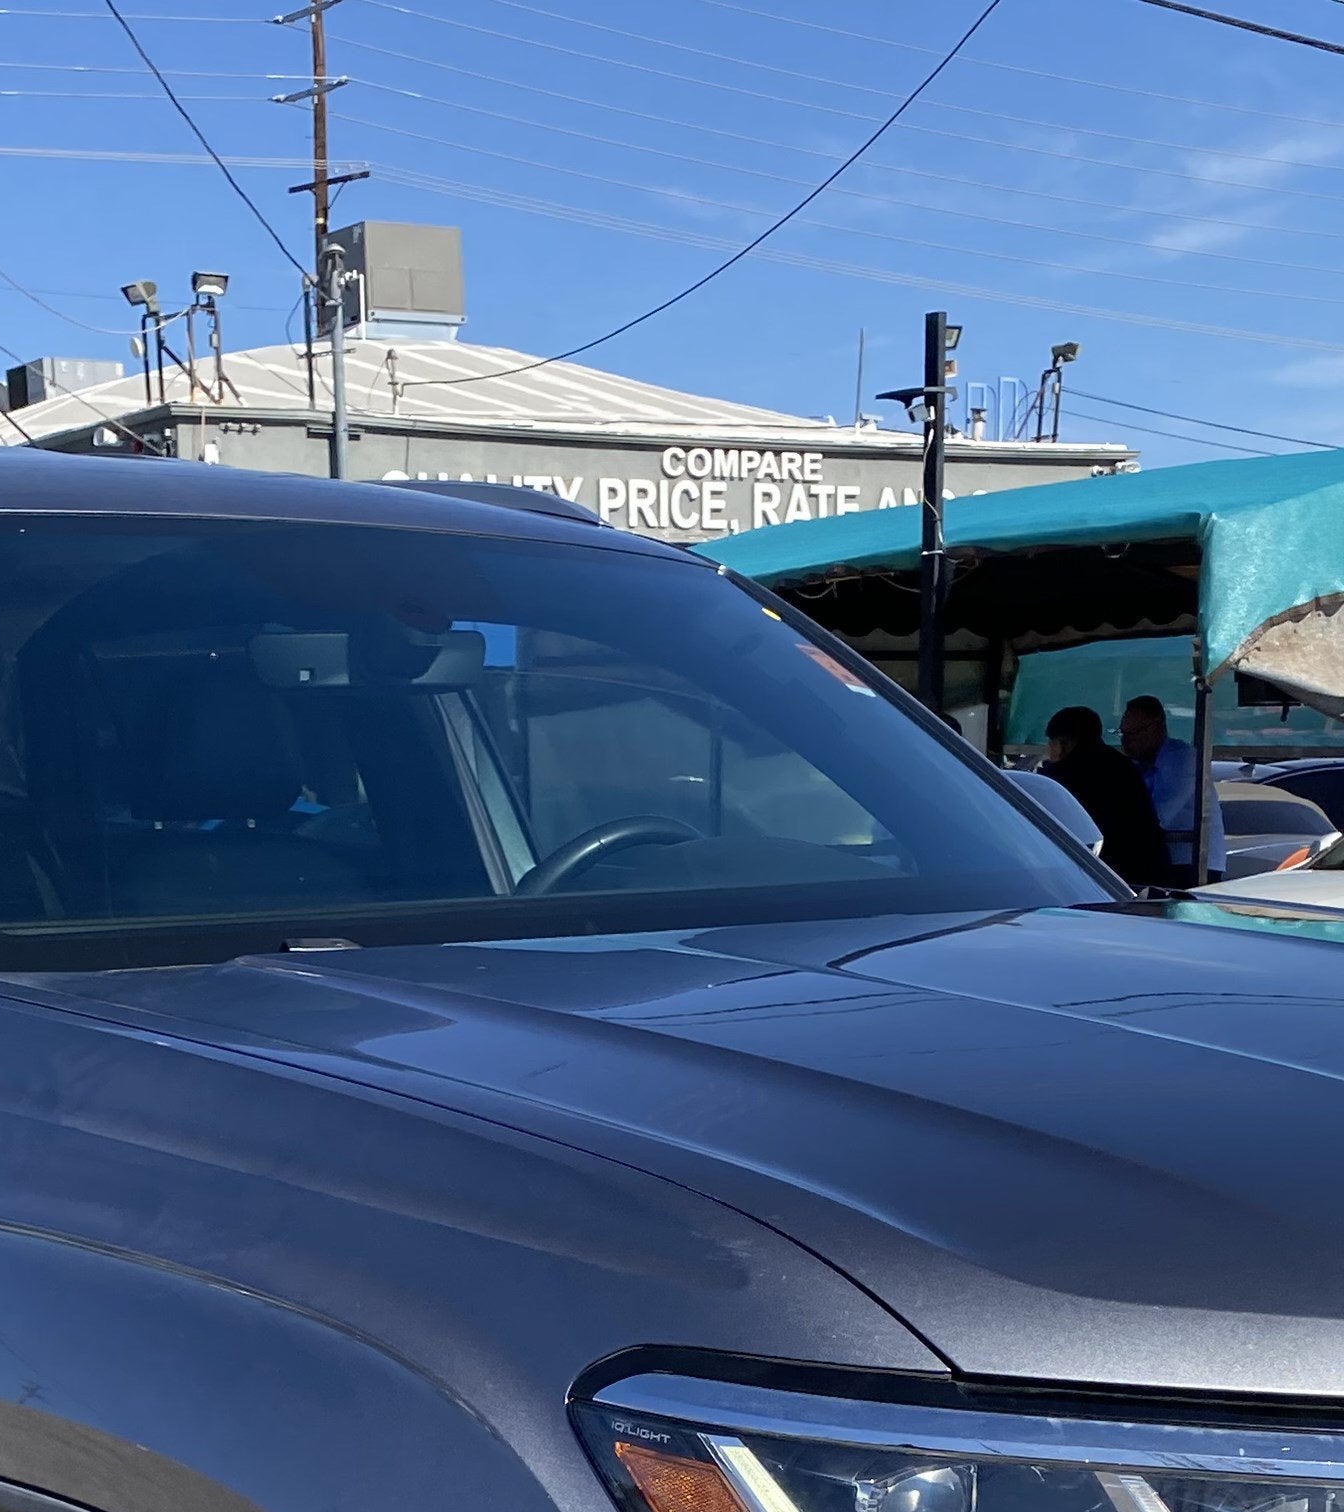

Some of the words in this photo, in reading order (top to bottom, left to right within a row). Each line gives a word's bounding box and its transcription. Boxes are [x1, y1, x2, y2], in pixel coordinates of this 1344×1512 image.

[661, 447, 824, 483] COMPARE
[598, 477, 740, 533] PRICE,
[753, 482, 861, 529] RATE
